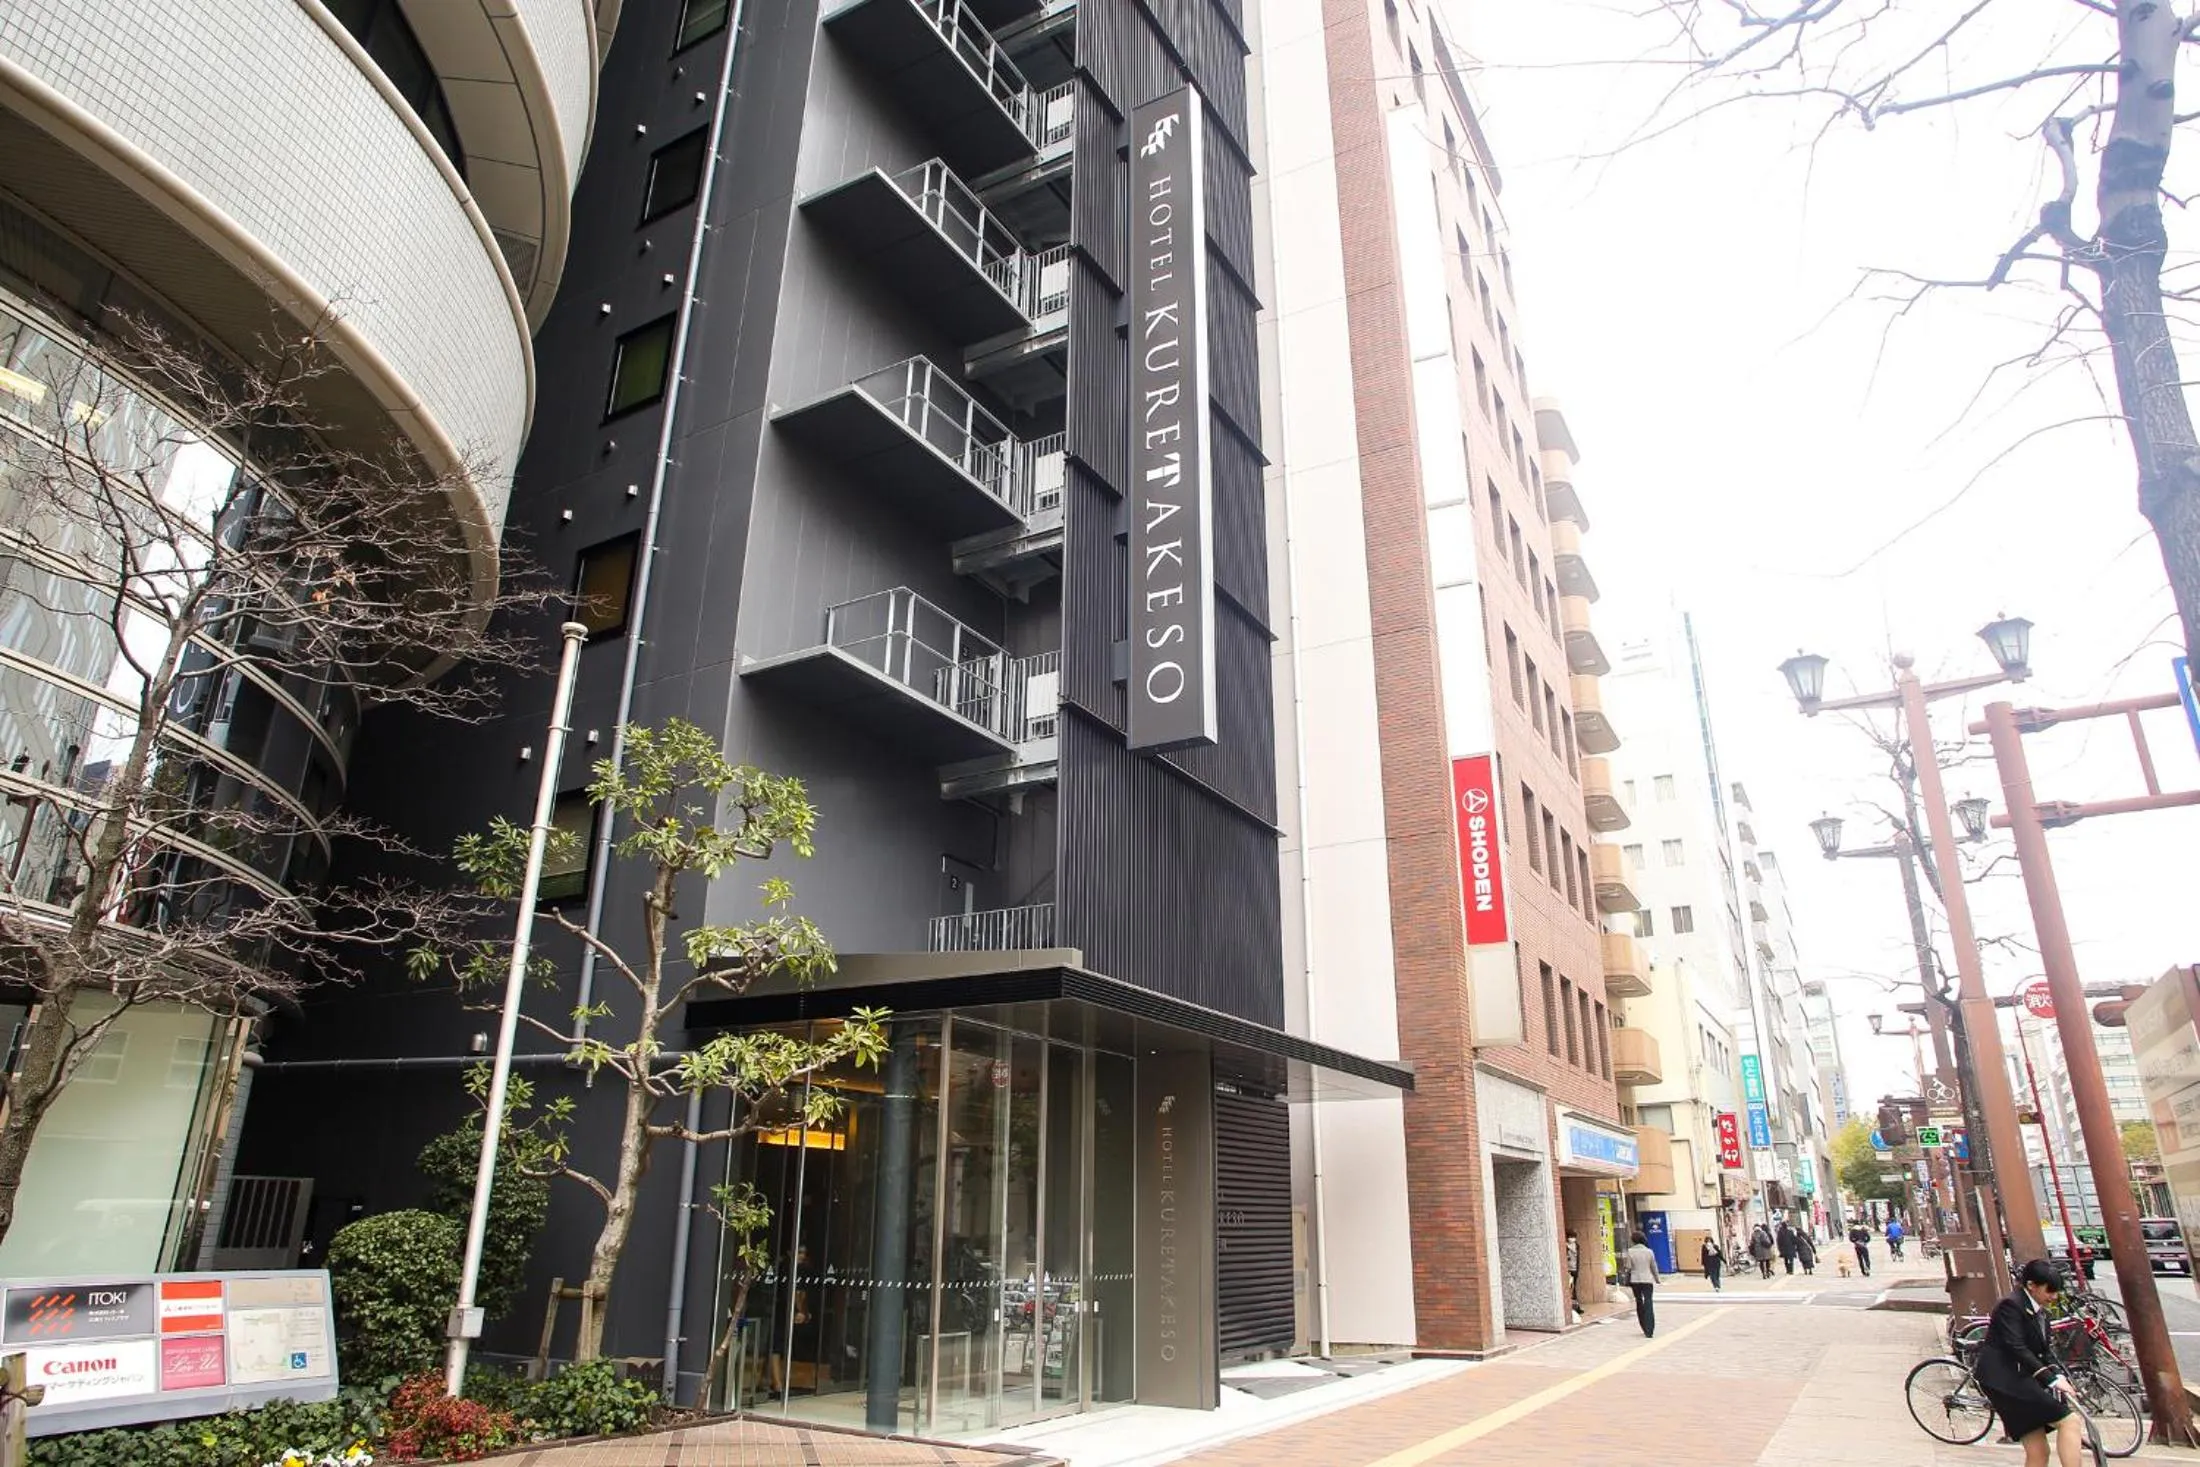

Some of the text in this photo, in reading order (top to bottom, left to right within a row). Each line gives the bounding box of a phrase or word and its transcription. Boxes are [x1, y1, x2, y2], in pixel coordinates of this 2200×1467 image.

[1145, 175, 1185, 704] HOTEL KURETAKESO
[1469, 816, 1493, 911] SHODEN
[1720, 1119, 1739, 1163] なか卯
[1160, 1127, 1178, 1363] HOTEL KURETAKESO
[88, 1291, 127, 1305] ITOKI
[43, 1357, 117, 1376] Canon
